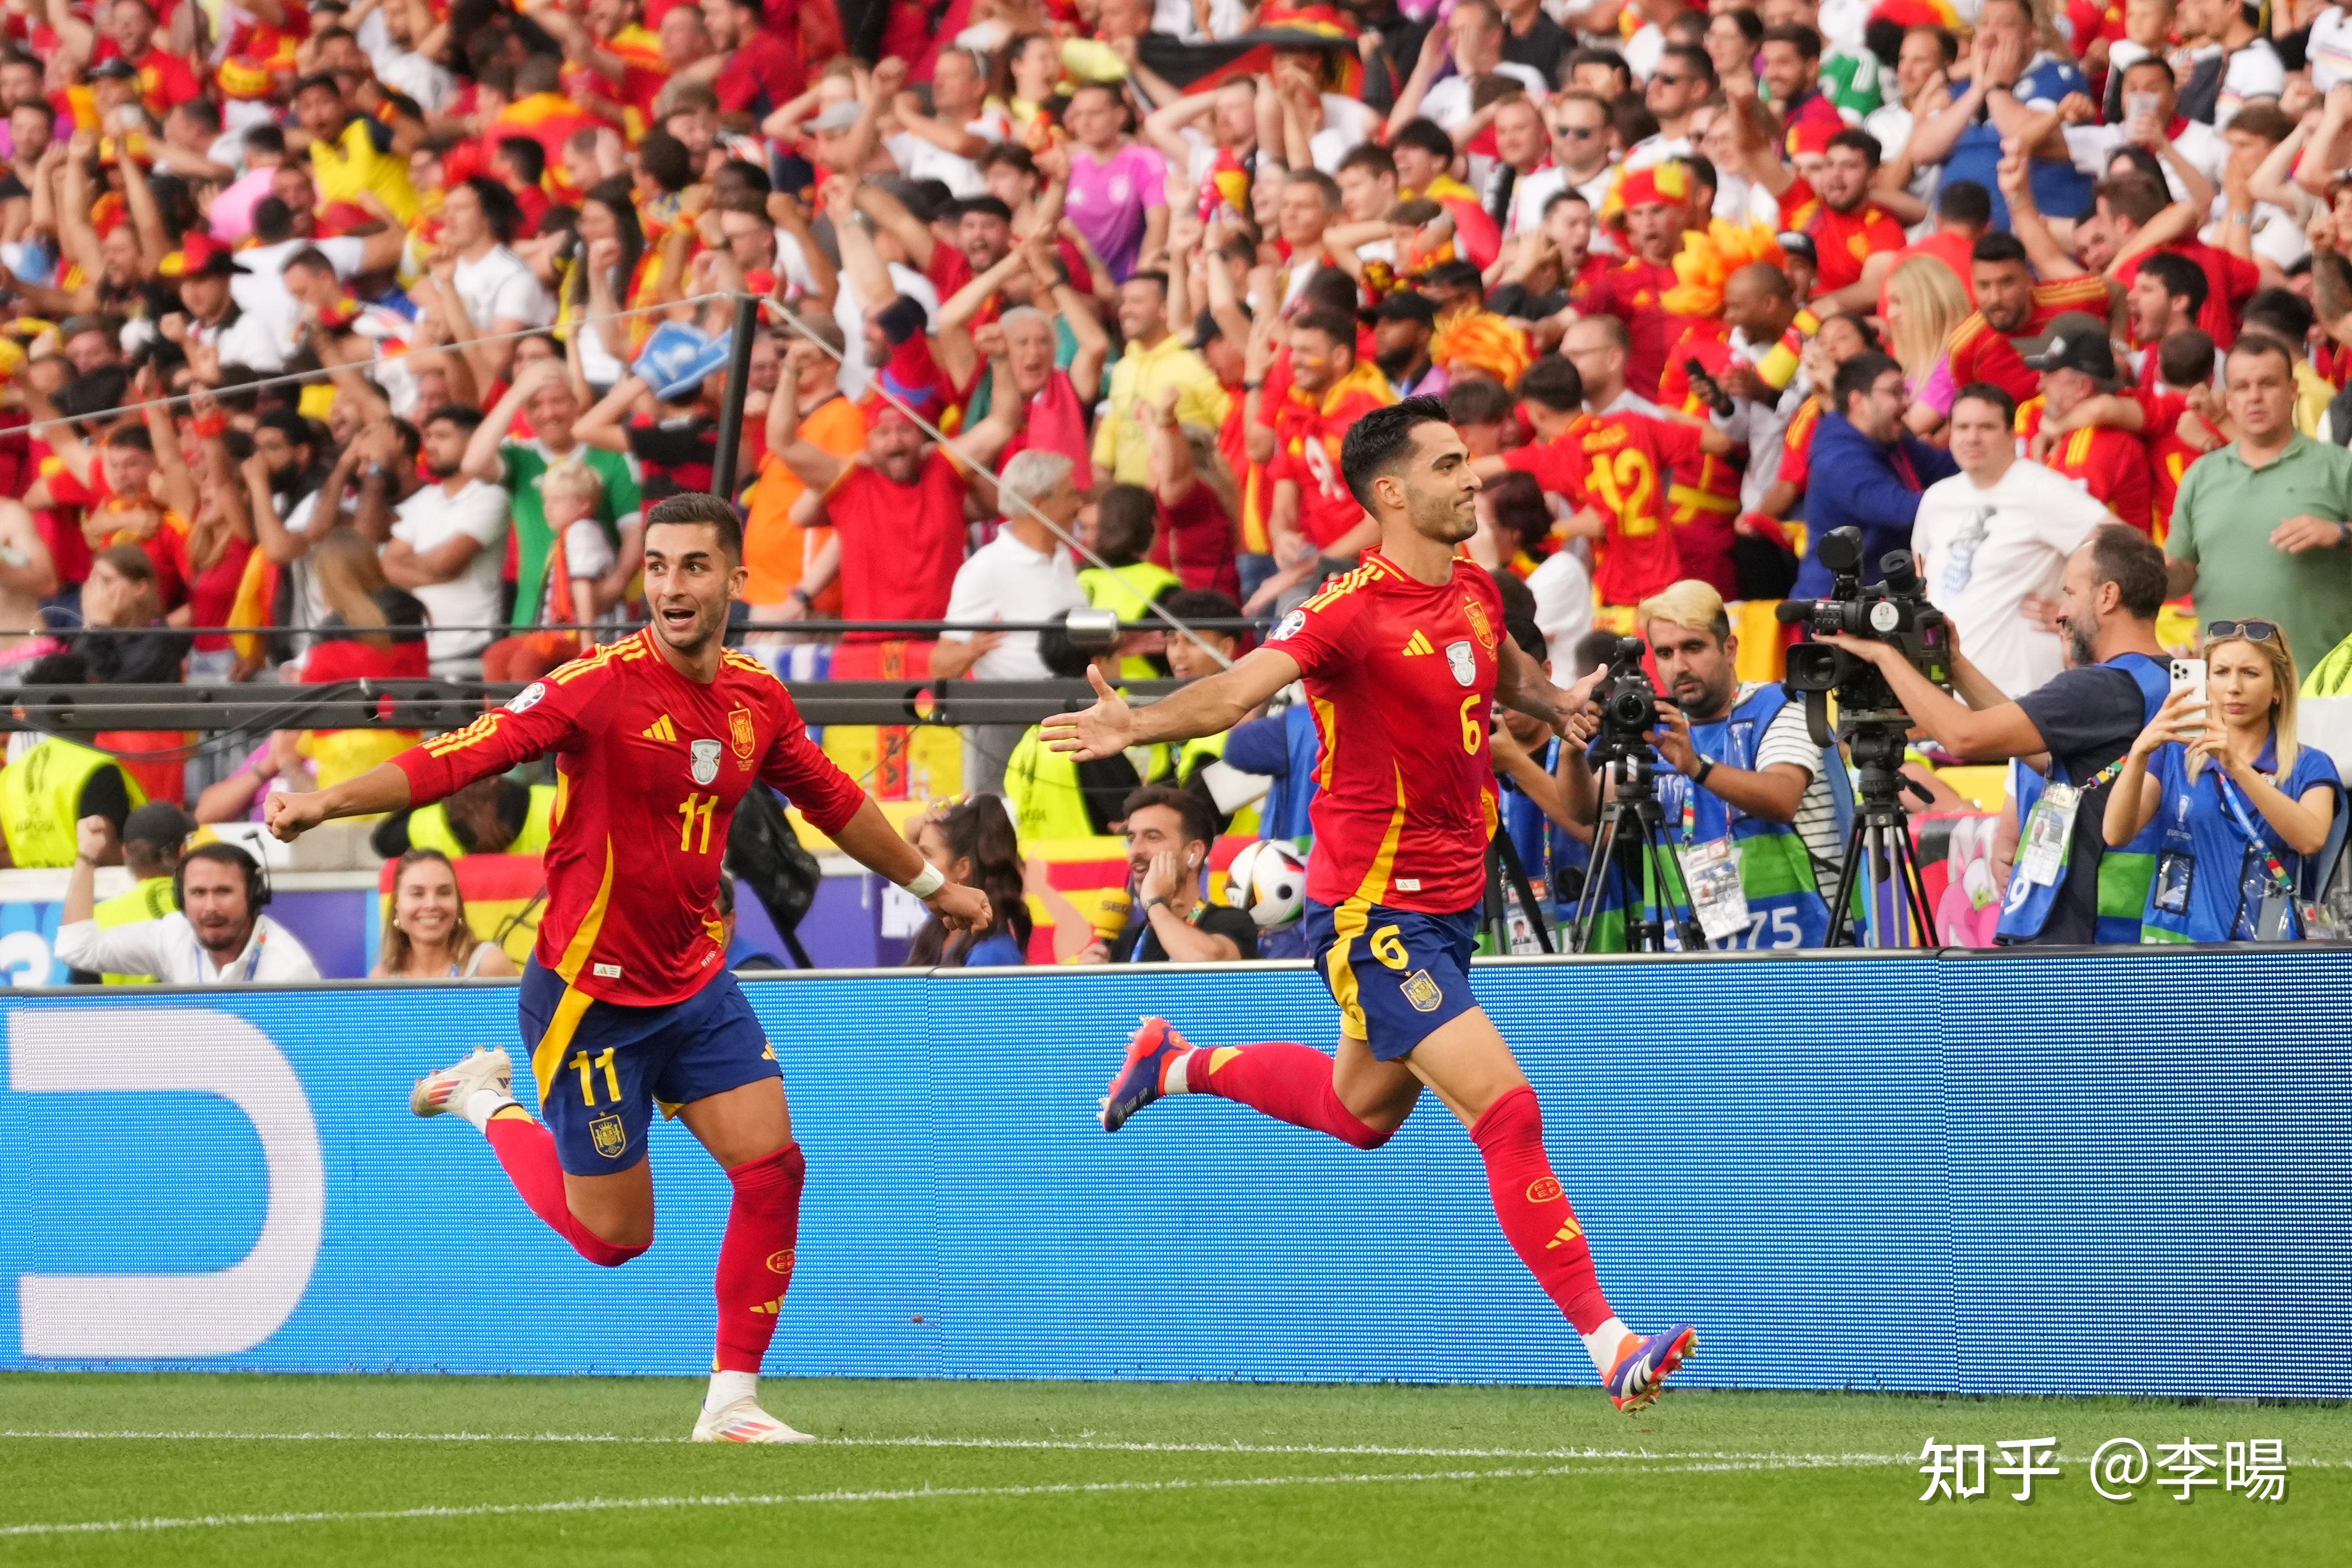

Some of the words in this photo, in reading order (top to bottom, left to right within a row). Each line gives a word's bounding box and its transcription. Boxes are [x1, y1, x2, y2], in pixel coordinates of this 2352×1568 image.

[1586, 448, 1657, 537] 12
[1460, 694, 1481, 755] 6
[679, 793, 719, 854] 11
[1370, 924, 1409, 970] 6
[568, 1047, 622, 1107] 11
